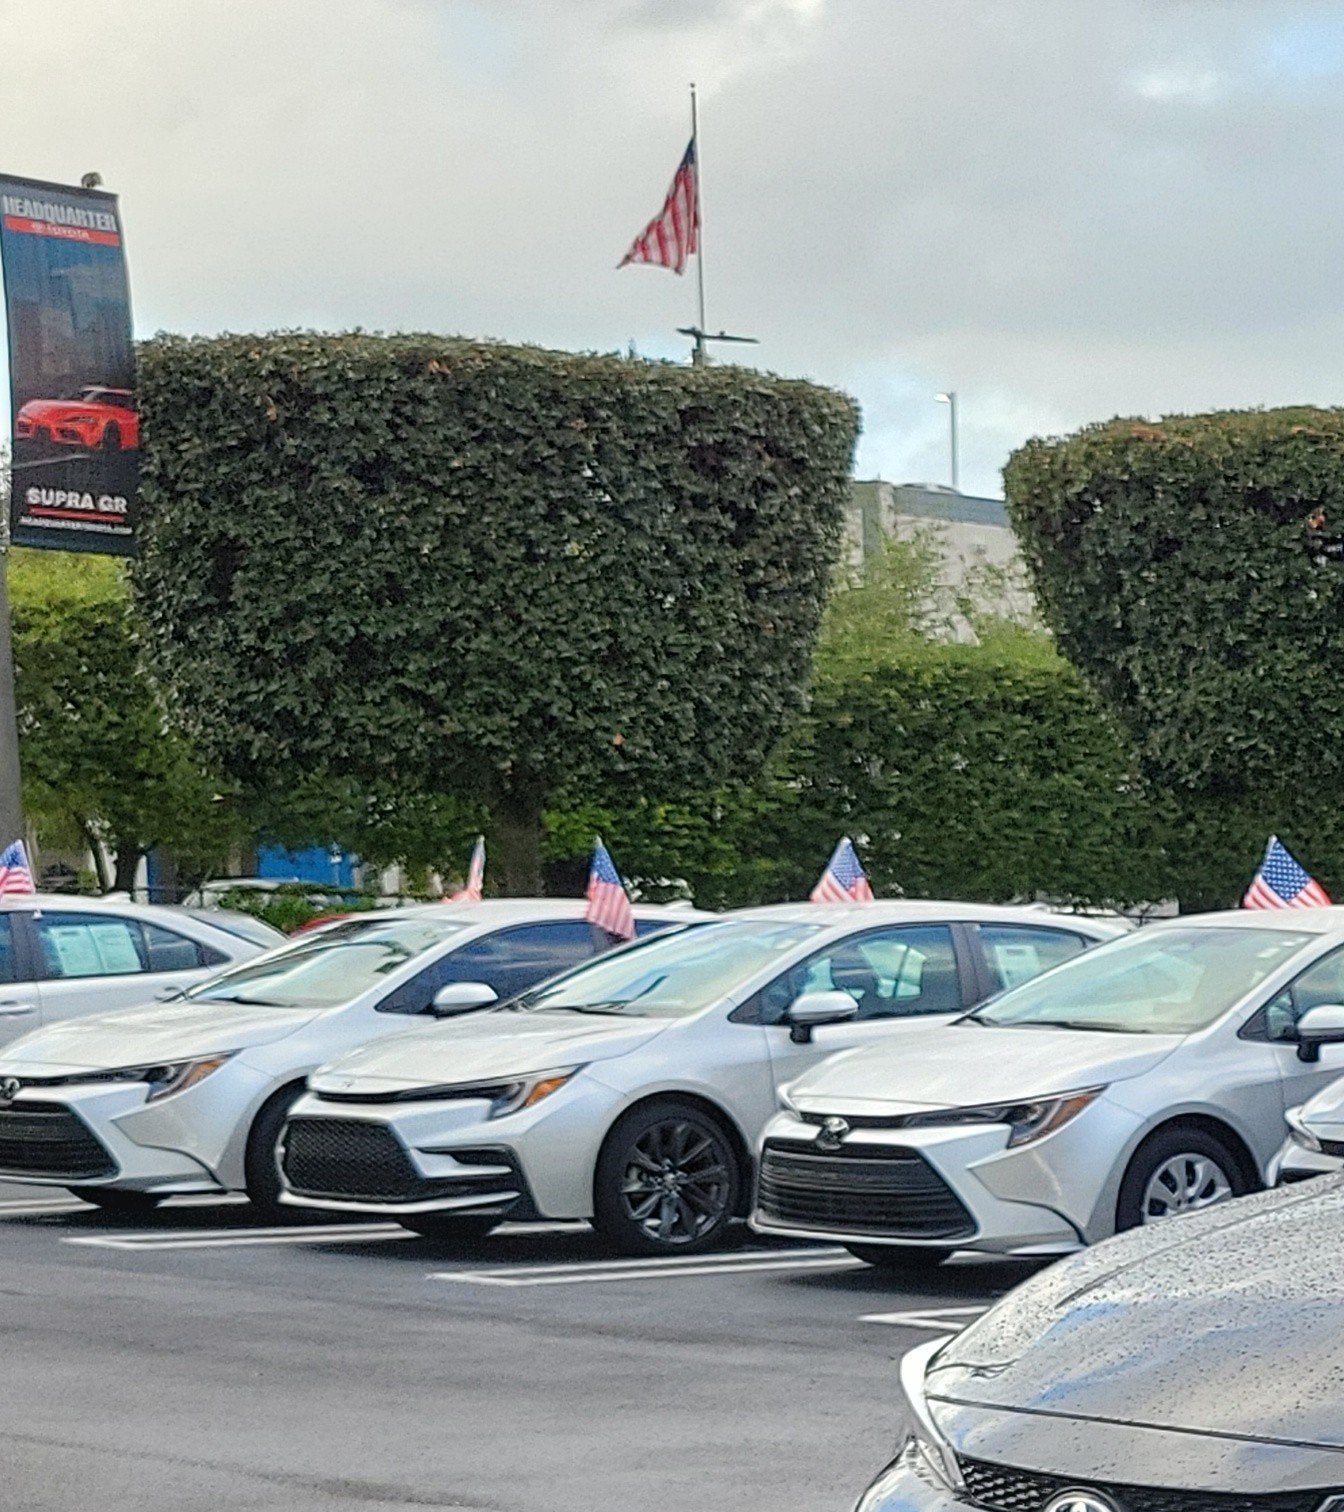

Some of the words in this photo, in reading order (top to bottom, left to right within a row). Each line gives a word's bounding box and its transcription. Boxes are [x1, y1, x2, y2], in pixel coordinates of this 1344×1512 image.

[2, 194, 118, 232] HEADQUARTER
[26, 487, 95, 511] SUPRA
[98, 494, 128, 514] GR
